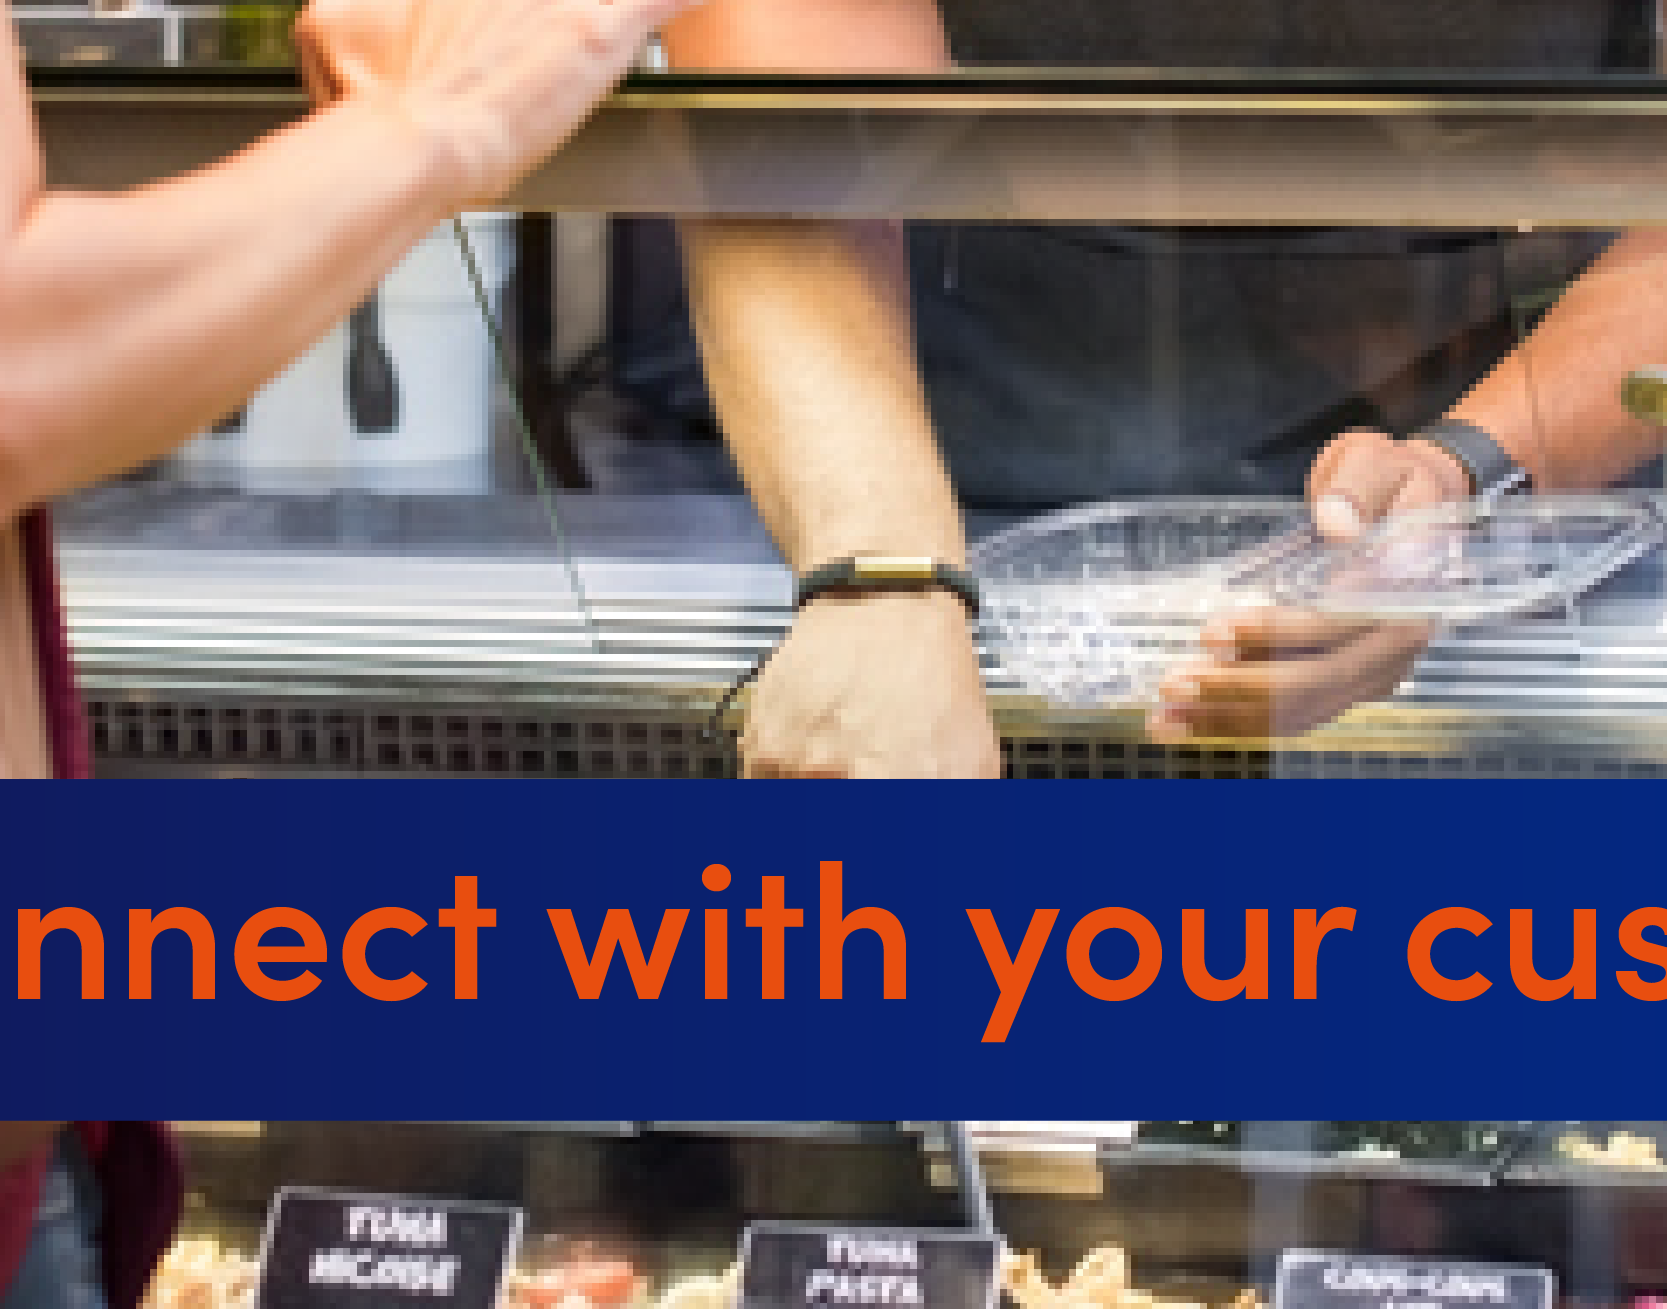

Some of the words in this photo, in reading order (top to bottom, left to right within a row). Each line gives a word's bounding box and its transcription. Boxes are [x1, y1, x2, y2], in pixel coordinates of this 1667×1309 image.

[345, 1206, 448, 1245] TUNA
[826, 1235, 918, 1270] TUNA
[805, 1268, 924, 1308] PASTA
